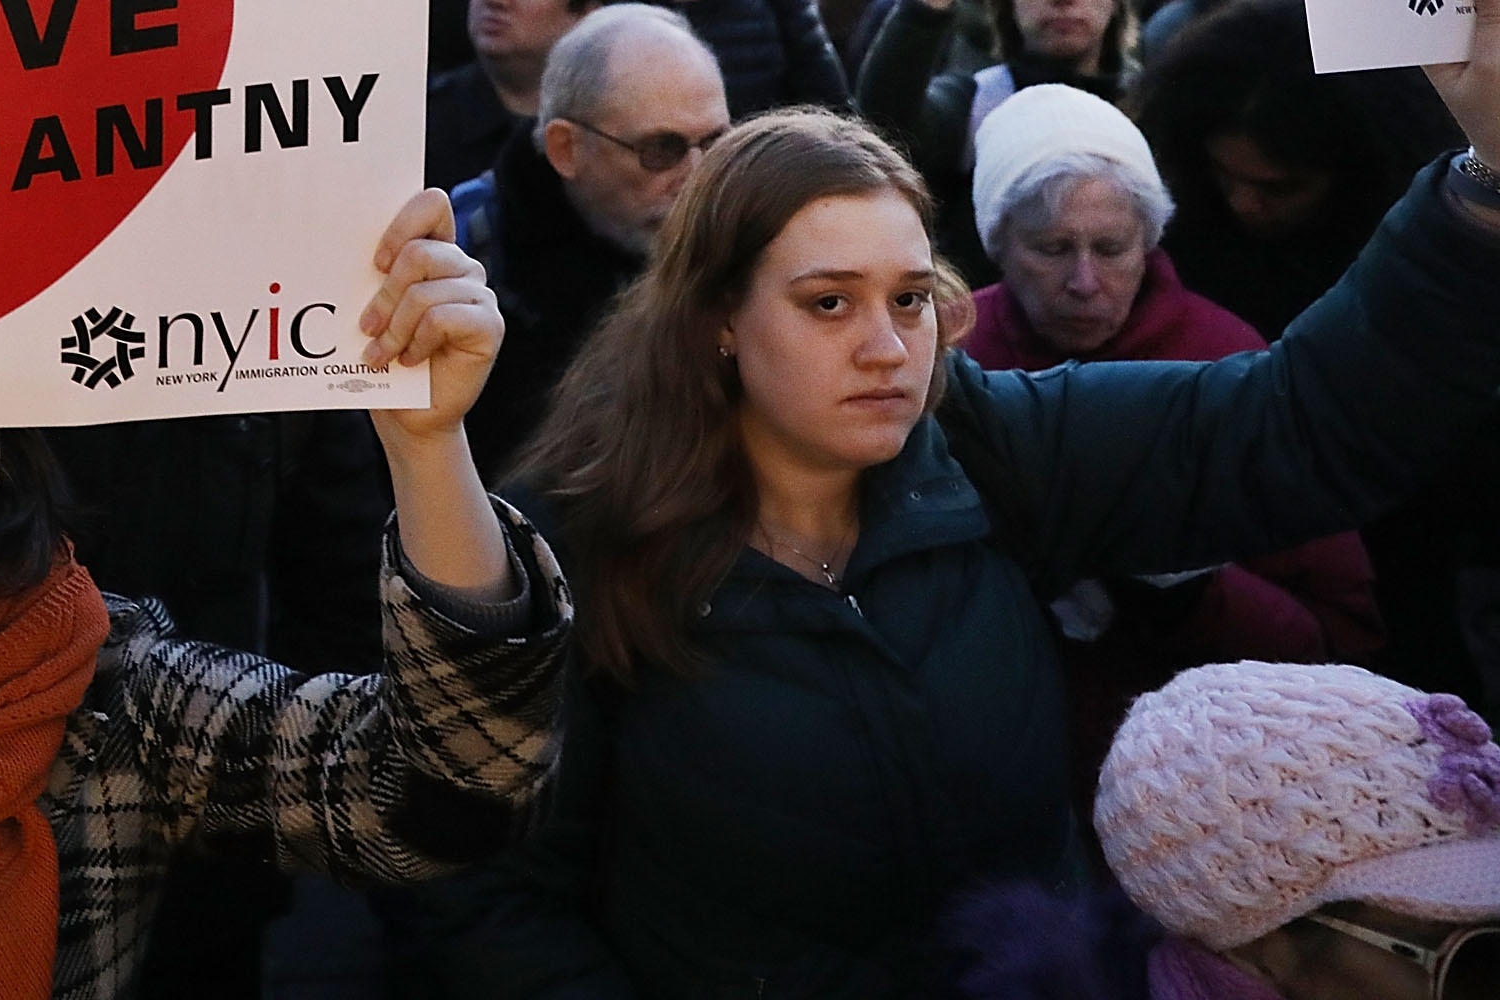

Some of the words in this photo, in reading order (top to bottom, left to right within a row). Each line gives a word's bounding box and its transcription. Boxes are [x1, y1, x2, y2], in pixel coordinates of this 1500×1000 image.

[157, 282, 338, 392] nyic
[155, 374, 184, 387] NEW
[186, 371, 219, 384] YORK
[234, 364, 319, 381] IMMIGRATION
[323, 362, 390, 376] COALITION
